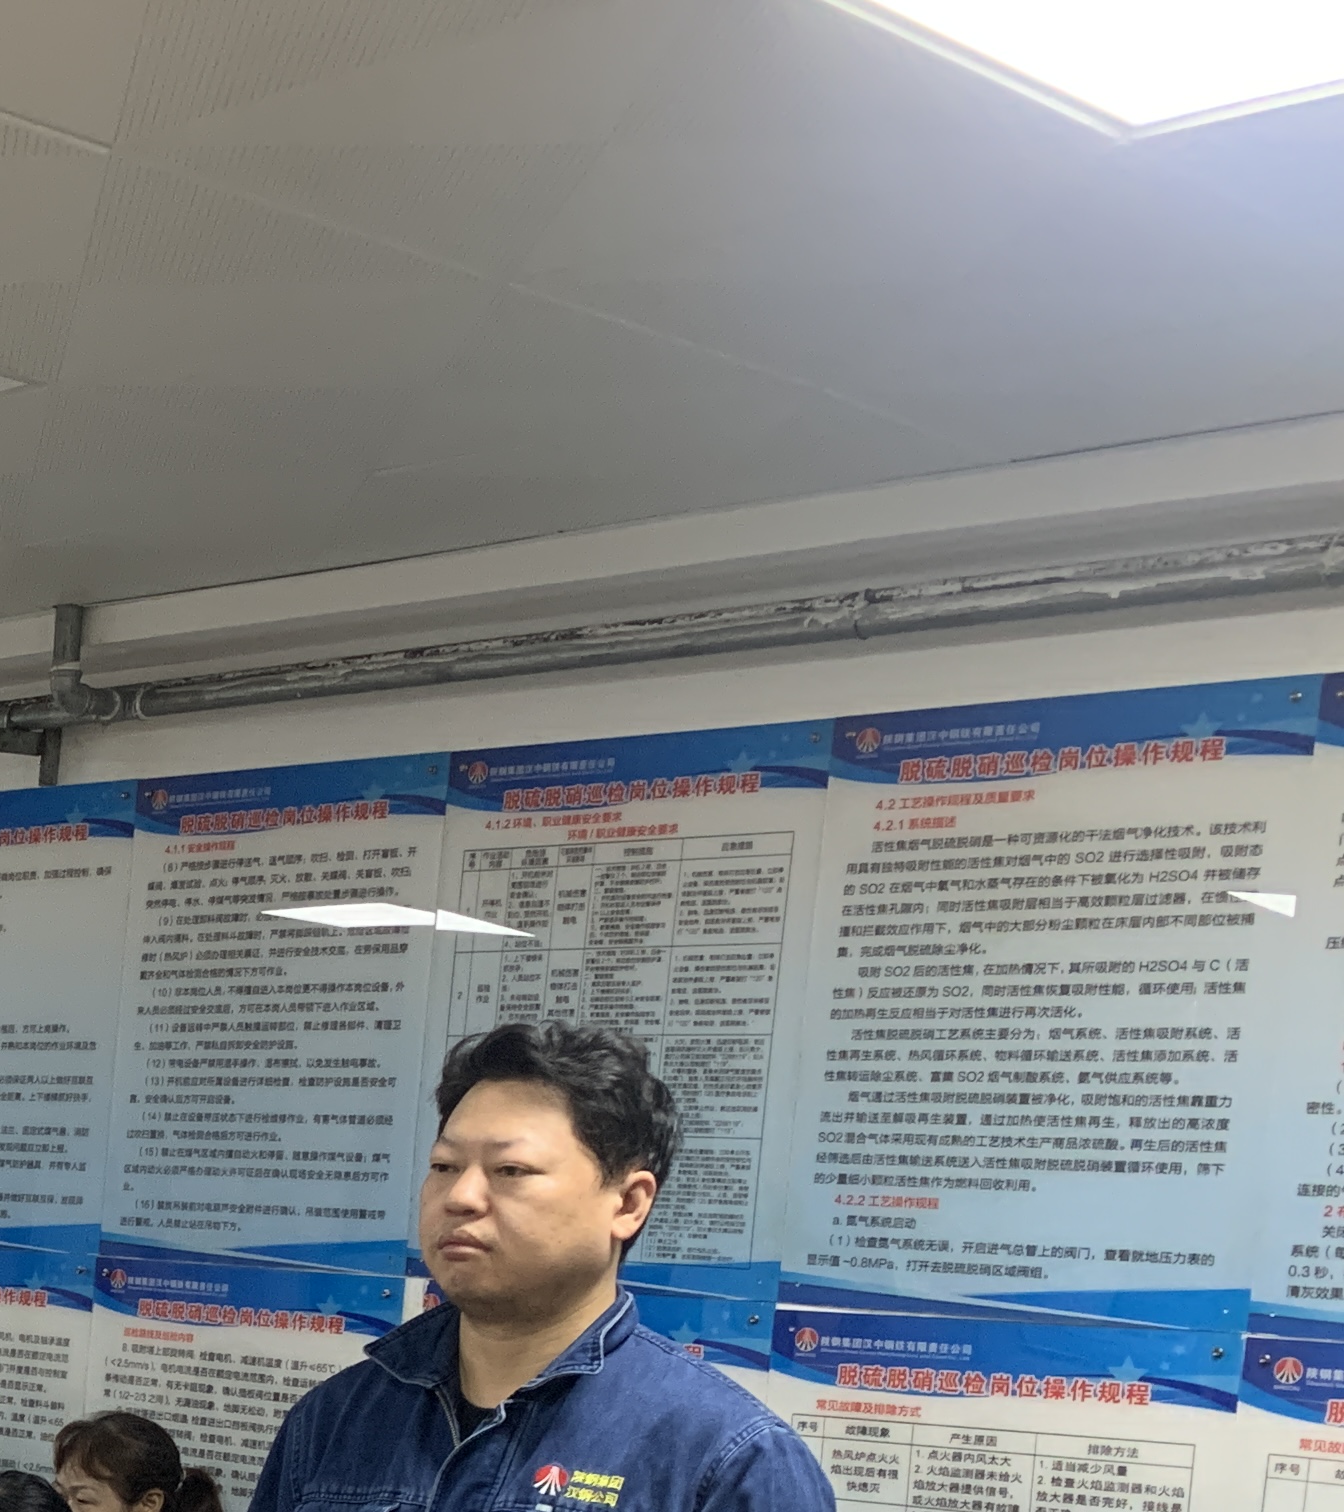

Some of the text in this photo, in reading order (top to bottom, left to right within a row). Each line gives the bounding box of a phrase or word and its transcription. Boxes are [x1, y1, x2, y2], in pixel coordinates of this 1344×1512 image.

[899, 737, 1226, 784] 脱硫脱硝巡检岗位操作规程
[503, 773, 761, 811] 脱硫脱硝巡检岗位操作规程
[876, 789, 1036, 811] 4.2 工艺操作规程及质量要求
[179, 801, 389, 834] 脱硫脱硝巡检岗位操作规程
[485, 819, 511, 830] 4.1.2
[874, 816, 957, 832] 4.2.1 系统描述
[871, 821, 1267, 854] 活性焦烟气脱硫脱硝是一种可资源化的干法烟气净化技术。该技术利
[846, 852, 1071, 874] 用具有独特吸附性能的活性焦对烟气中的
[1075, 851, 1104, 864] SO2
[844, 884, 855, 896] 的
[859, 882, 885, 895] SO2
[1149, 869, 1199, 882] H2SO4
[1204, 866, 1261, 881] 并被储存
[837, 942, 989, 958] 集，完成烟气脱硫除尘净化。
[858, 967, 880, 979] 吸附
[885, 965, 910, 978] SO2
[1139, 960, 1187, 973] H2SO4
[1193, 960, 1205, 973] 与
[830, 1005, 1083, 1021] 的加热再生反应相当于对活性焦进行再次活化。
[851, 1026, 1241, 1042] 活性焦脱硫脱硝工艺系统主要分为：烟气系统、活性焦吸附系统、活
[826, 1048, 1238, 1064] 性焦再生系统、热风循环系统、物料循环输送系统、活性焦添加系统、活
[957, 1071, 985, 1083] SO2
[848, 1090, 1232, 1109] 烟气通过活性焦吸附脱硫脱硝装置被净化，吸附饱和的活性焦靠重力
[814, 1173, 1037, 1192] 的少量细小颗粒活性焦作为燃料回收利用。
[835, 1195, 939, 1210] 4.2.2 工艺操作规程
[1288, 1264, 1310, 1278] 0.3
[137, 1298, 346, 1335] 脱硫脱硝巡检岗位操作规程
[820, 1336, 972, 1356] 陕钢集团汉中钢铁有限责任公司
[837, 1363, 1152, 1406] 脱硫脱硝巡检岗位操作规程
[815, 1399, 922, 1418] 常见故障及排除方式
[796, 1420, 819, 1434] 序号
[845, 1424, 890, 1438] 故障现象
[950, 1432, 998, 1448] 产生原因
[832, 1448, 900, 1465] 热风炉点火火
[927, 1449, 1011, 1467] 点火器内风太大
[1087, 1444, 1139, 1459] 排除方法
[830, 1465, 899, 1481] 焰出现后有很
[927, 1464, 1022, 1484] 火焰监测器未给火
[1052, 1459, 1128, 1478] 适当减少风量
[1274, 1462, 1300, 1476] 序号
[570, 1470, 625, 1491] 陕钢集团
[846, 1479, 880, 1494] 快熄灭
[1050, 1474, 1184, 1499] 检查火焰监测器和火焰
[563, 1486, 619, 1508] 汉钢公司
